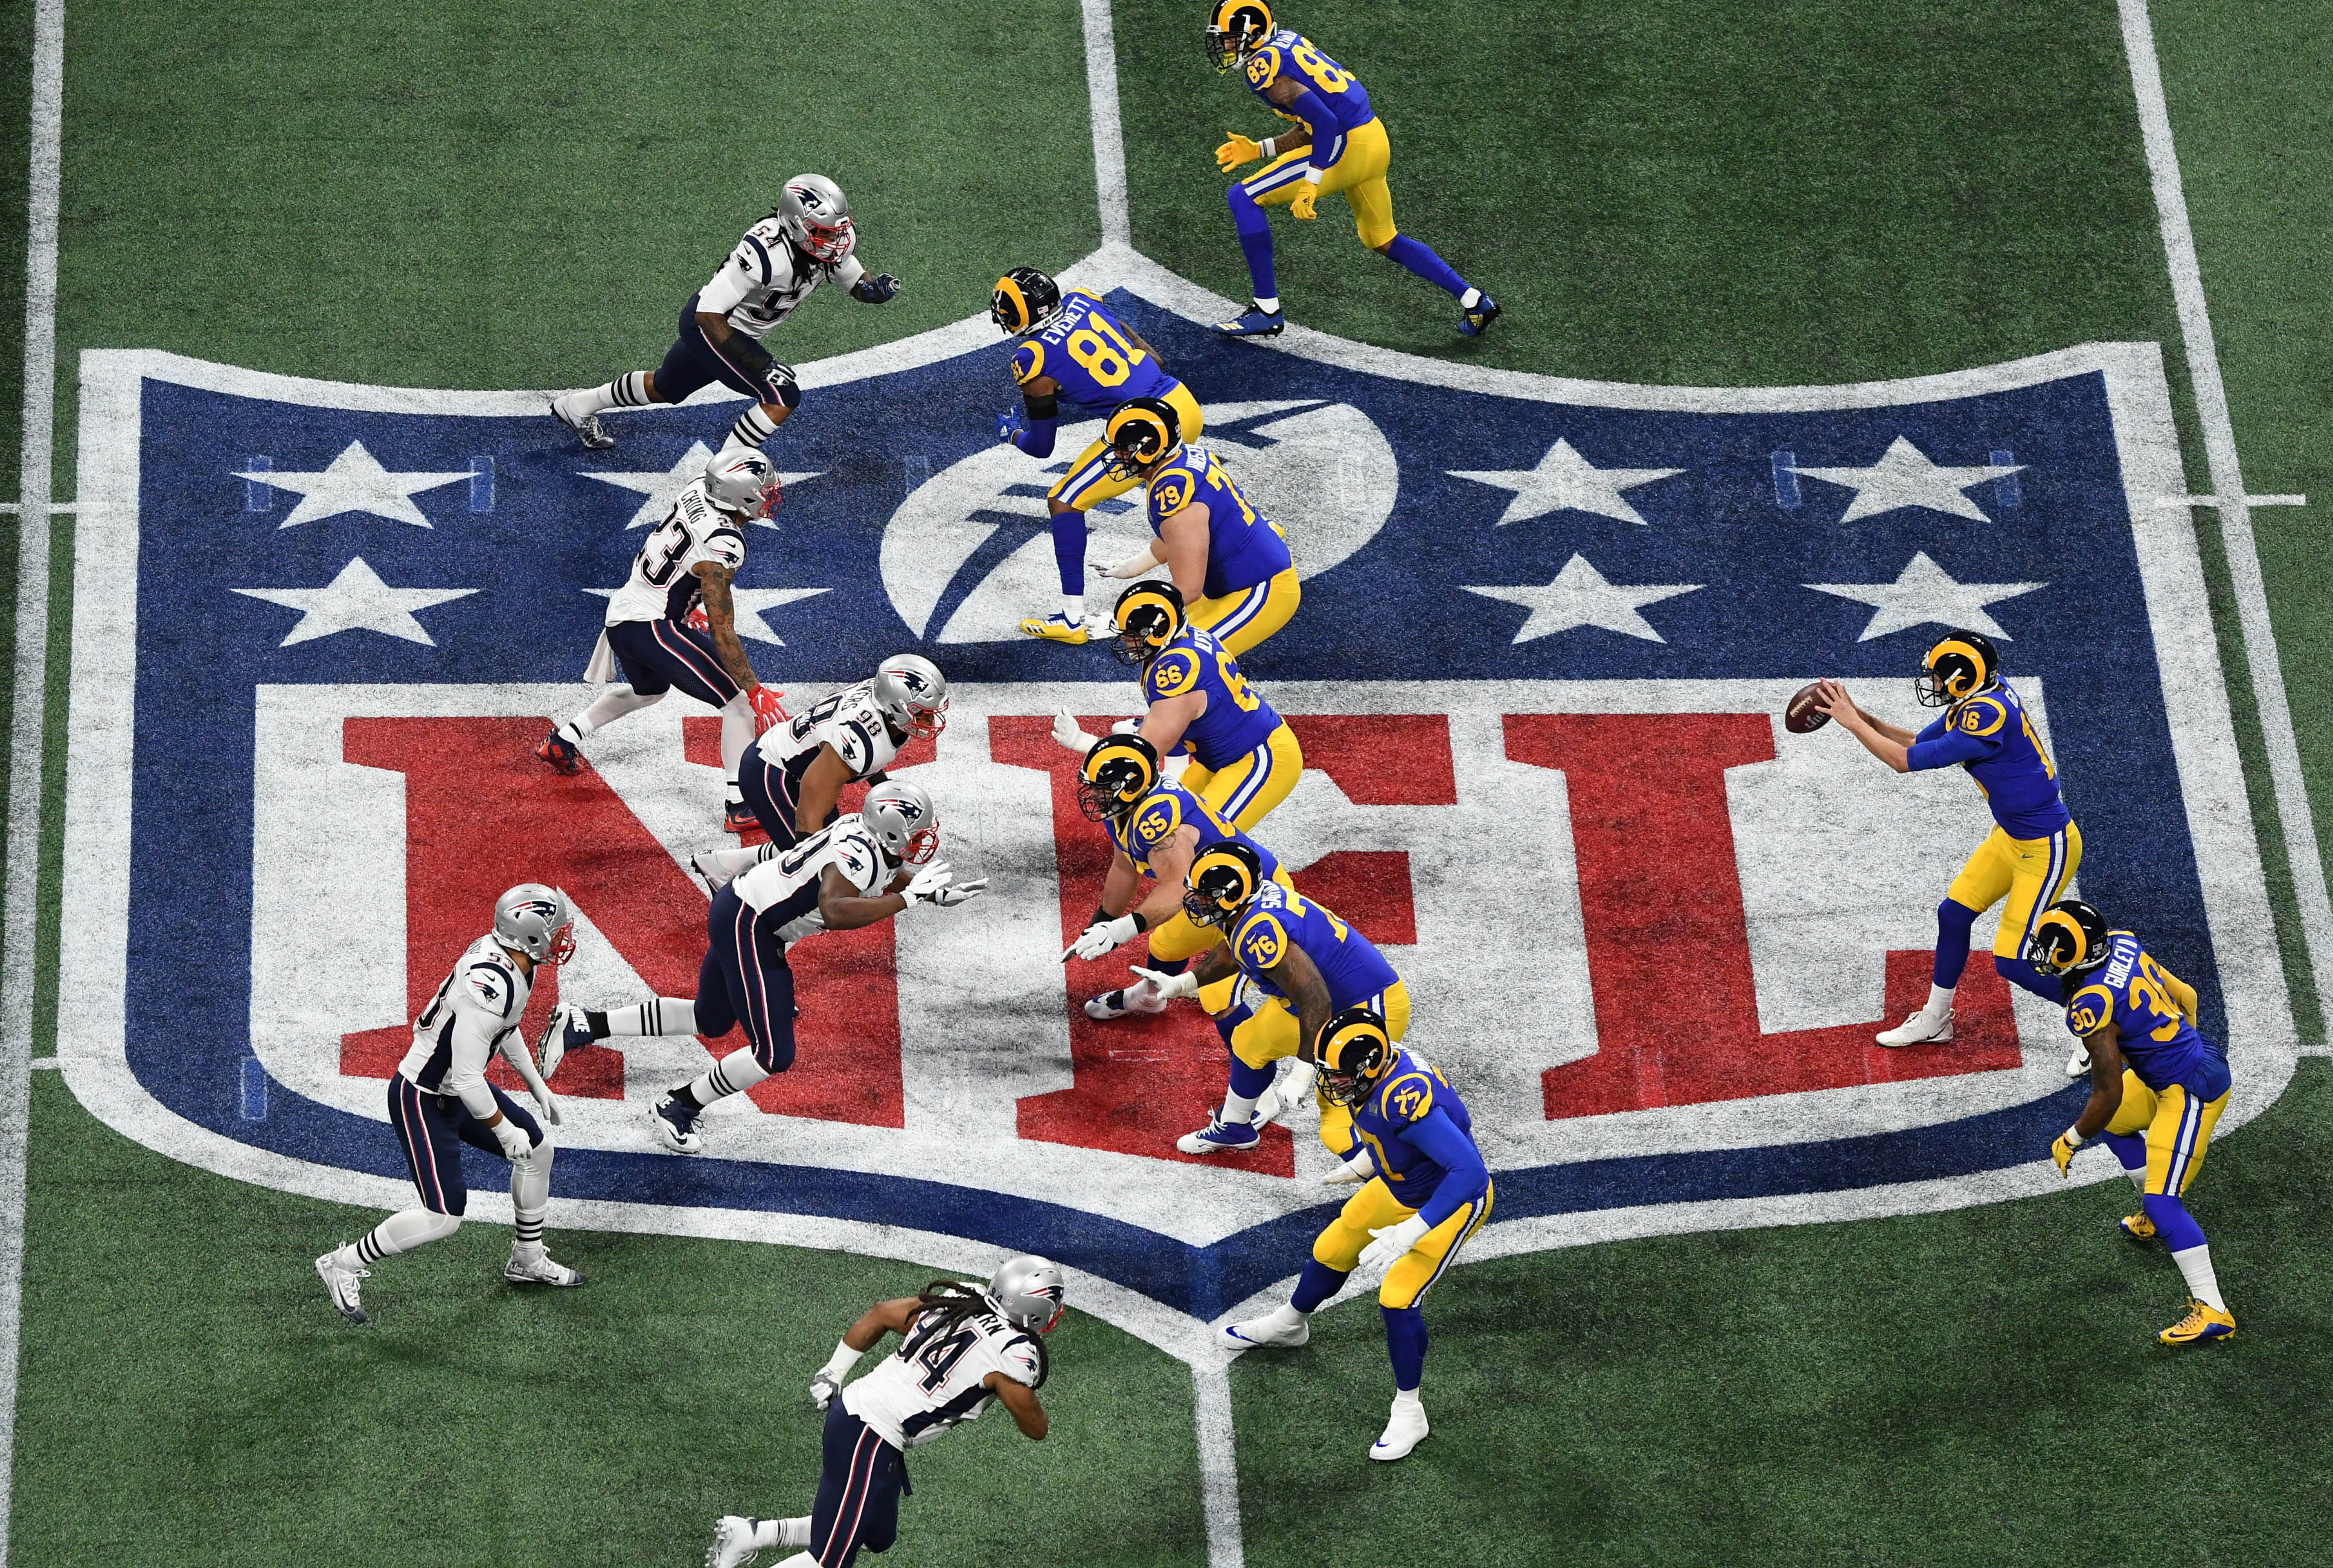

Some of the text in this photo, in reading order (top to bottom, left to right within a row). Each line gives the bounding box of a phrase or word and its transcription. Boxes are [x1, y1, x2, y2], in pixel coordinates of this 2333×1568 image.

[1247, 57, 1270, 84] 83
[752, 225, 783, 251] 54
[747, 288, 803, 324] 5
[1040, 296, 1090, 345] EVERETT
[1067, 311, 1147, 388] 81
[1154, 485, 1180, 511] 79
[1205, 452, 1256, 526] 7
[680, 490, 707, 524] CHUNG
[1155, 665, 1183, 688] 66
[1215, 651, 1261, 712] 6
[855, 709, 884, 738] 98
[1962, 710, 1980, 731] 16
[1139, 811, 1168, 840] 65
[341, 712, 2023, 1179] NFL
[1247, 935, 1276, 964] 76
[487, 952, 516, 973] 53
[2103, 945, 2136, 990] GURLEY
[2129, 952, 2183, 1042] 30
[569, 1005, 591, 1032] NIKE
[2070, 1008, 2096, 1031] 30
[1394, 1090, 1421, 1115] 77
